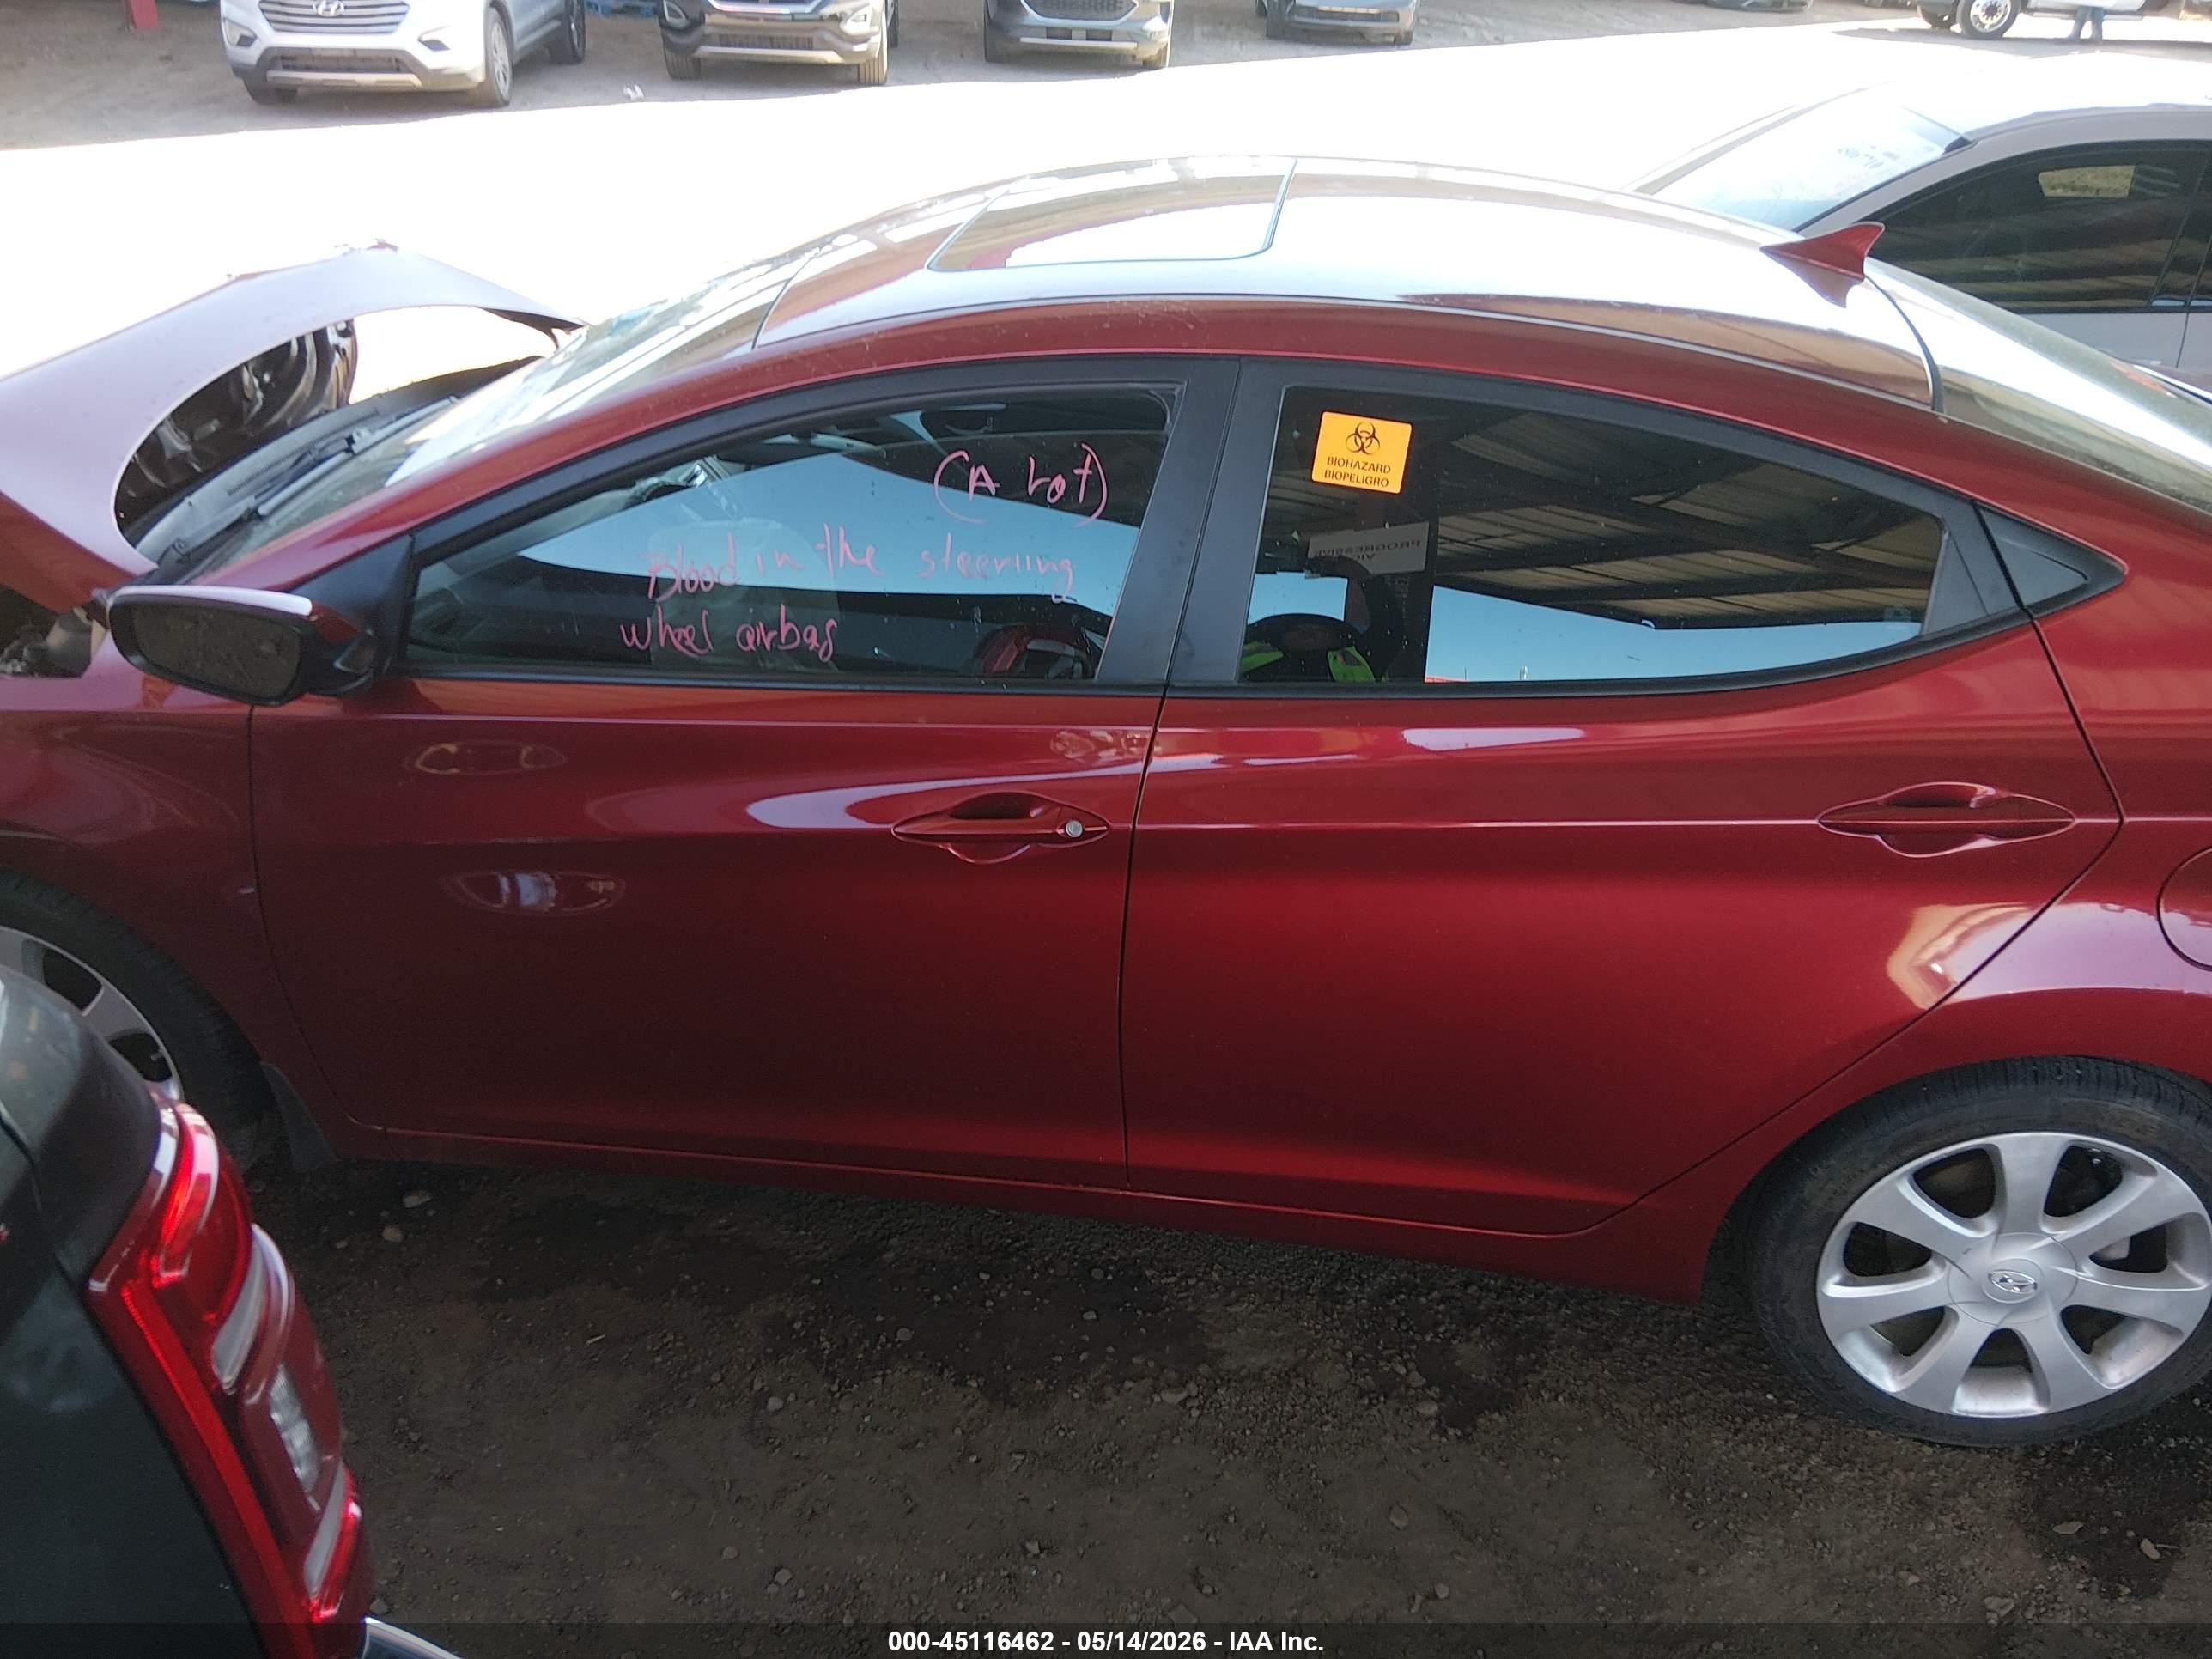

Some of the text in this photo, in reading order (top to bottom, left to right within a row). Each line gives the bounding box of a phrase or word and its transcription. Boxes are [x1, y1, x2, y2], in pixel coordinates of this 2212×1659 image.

[1327, 456, 1391, 474] BIOHAZARD
[1324, 469, 1389, 488] BIOPELIGRO
[756, 550, 805, 577] in
[816, 521, 885, 578] the
